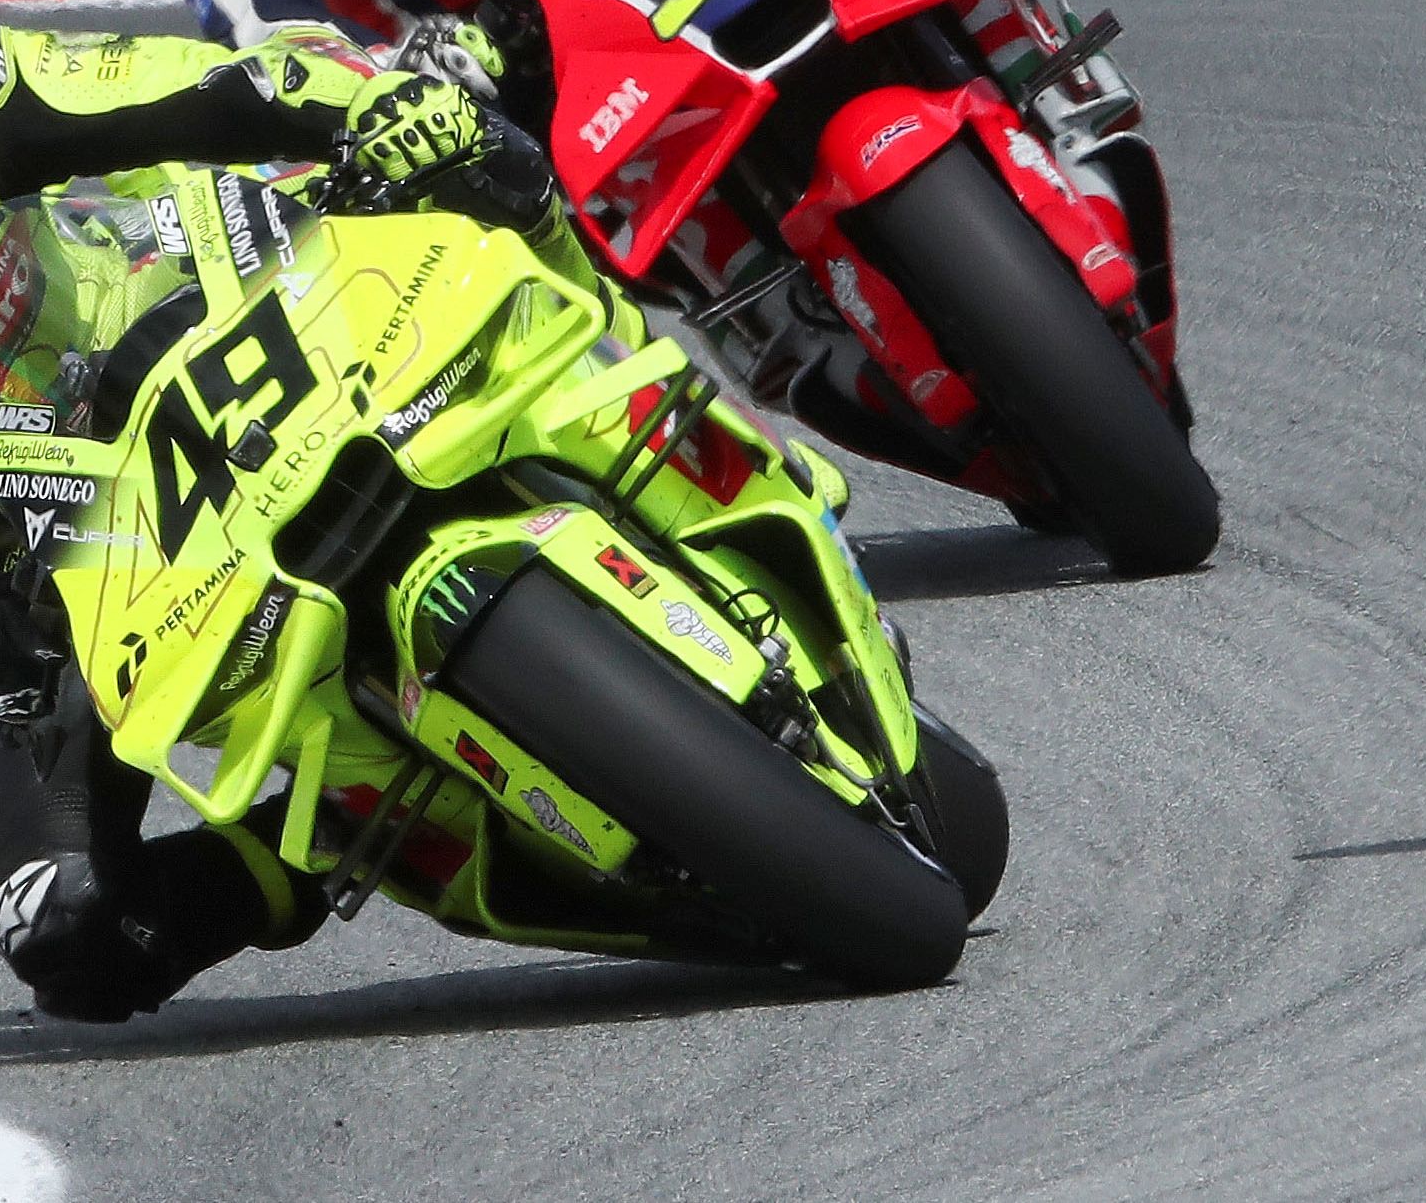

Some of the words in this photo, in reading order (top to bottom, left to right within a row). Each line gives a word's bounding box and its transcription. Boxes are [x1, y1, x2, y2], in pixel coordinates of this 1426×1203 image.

[578, 77, 651, 155] IBM
[376, 243, 448, 354] PERTAMINA
[144, 286, 320, 566] 49
[29, 477, 96, 504] SONEGO
[256, 430, 328, 518] HERO
[53, 523, 144, 548] CUPRA
[154, 546, 247, 641] PERTAMINA
